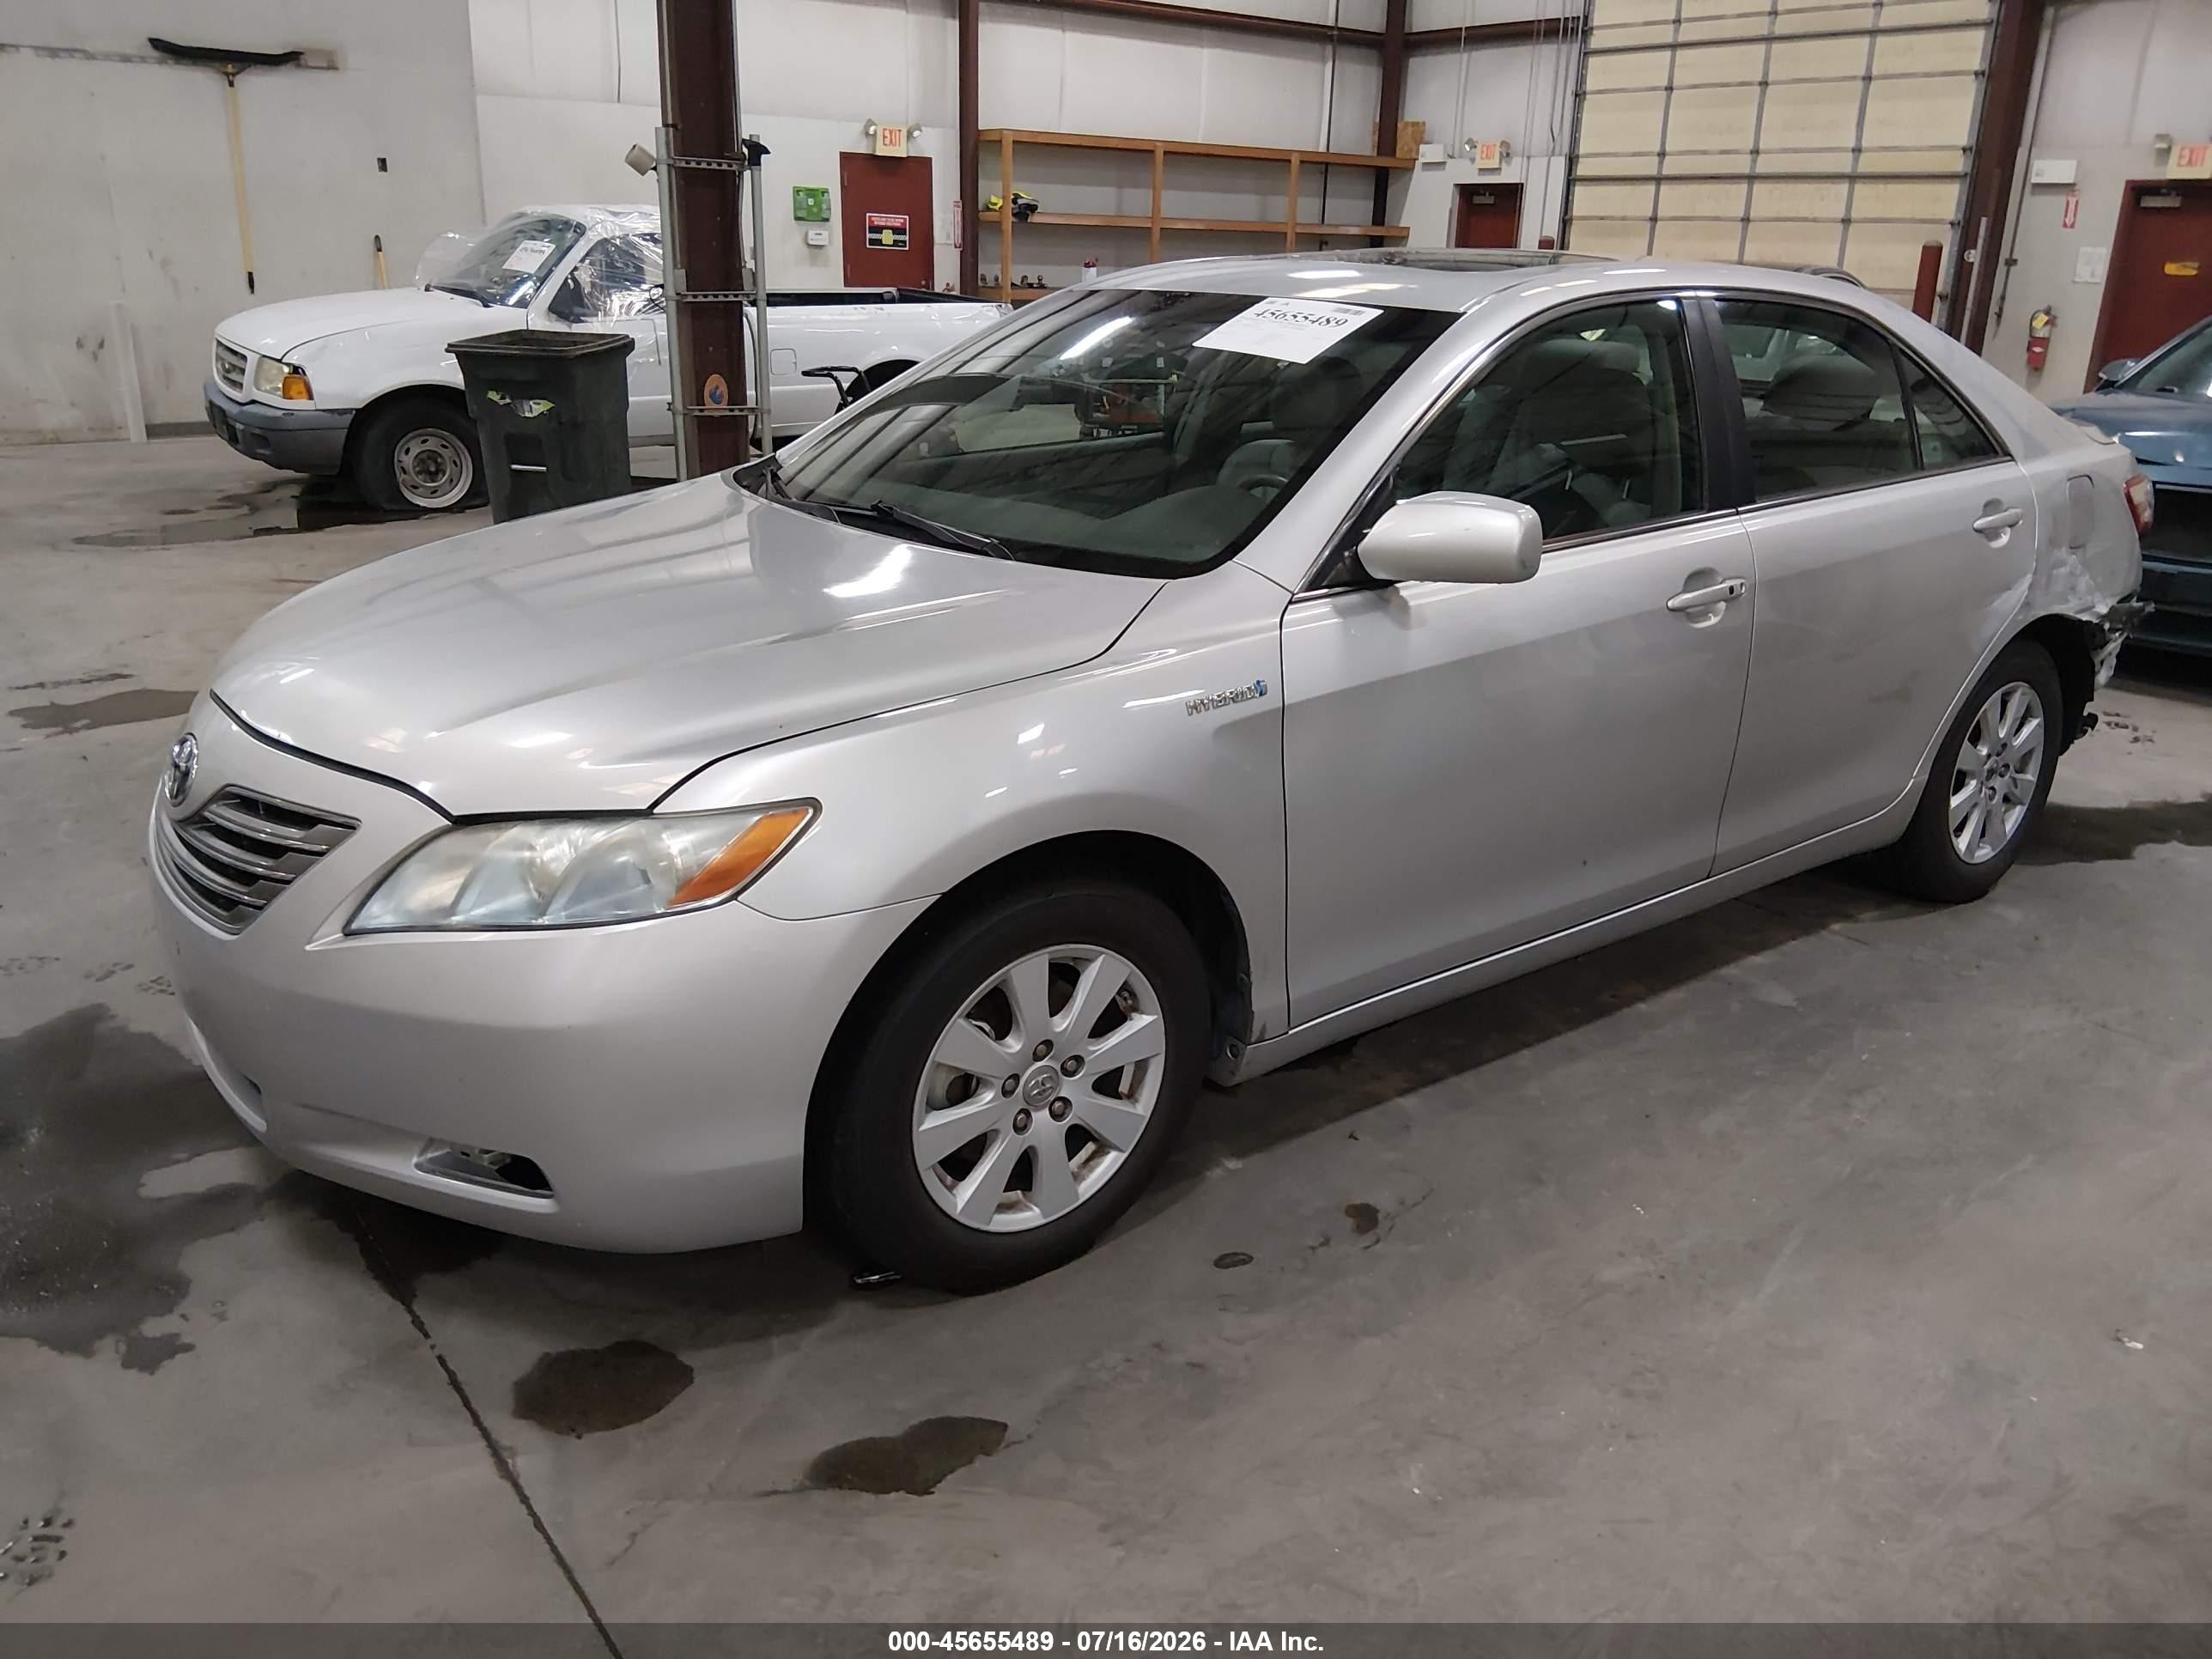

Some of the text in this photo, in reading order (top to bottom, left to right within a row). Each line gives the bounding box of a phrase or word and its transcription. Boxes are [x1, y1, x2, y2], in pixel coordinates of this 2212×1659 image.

[882, 128, 902, 147] EXIT
[1480, 143, 1498, 161] EXIT
[2177, 146, 2208, 167] EXIT
[1253, 307, 1349, 328] 45655489
[1185, 684, 1258, 716] HYBRID
